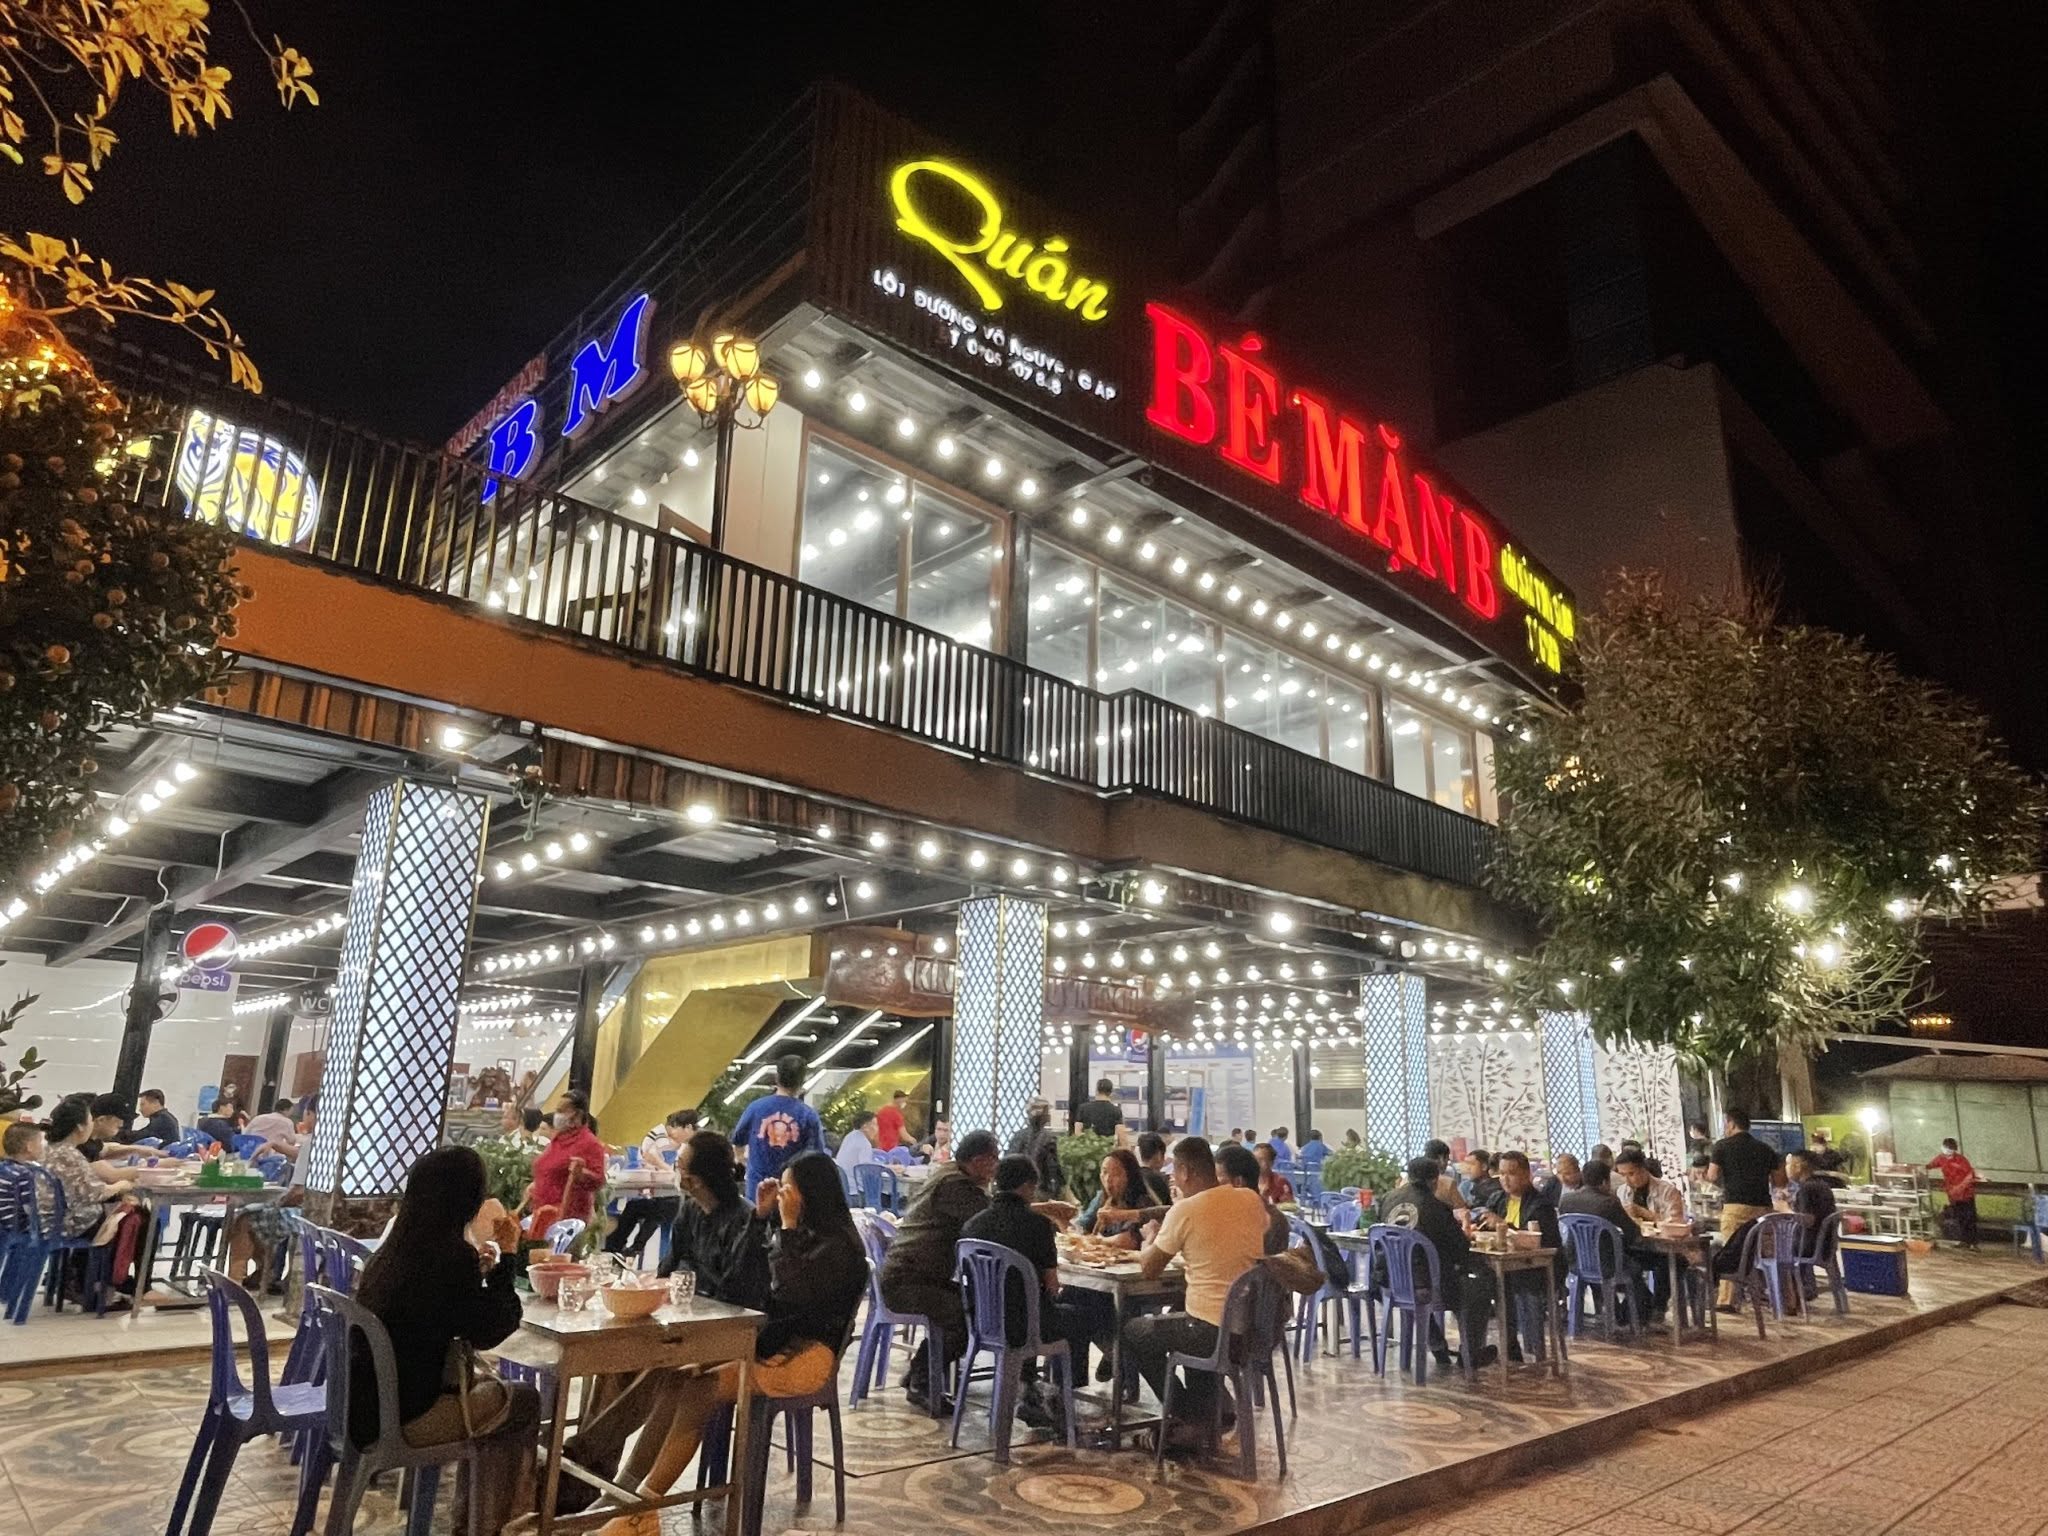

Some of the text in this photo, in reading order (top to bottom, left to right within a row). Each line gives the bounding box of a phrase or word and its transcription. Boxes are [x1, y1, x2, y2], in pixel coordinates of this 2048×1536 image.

[890, 160, 1109, 322] Quán
[1145, 302, 1280, 484] BÉ
[180, 972, 225, 989] pepsi
[300, 995, 329, 1011] WC
